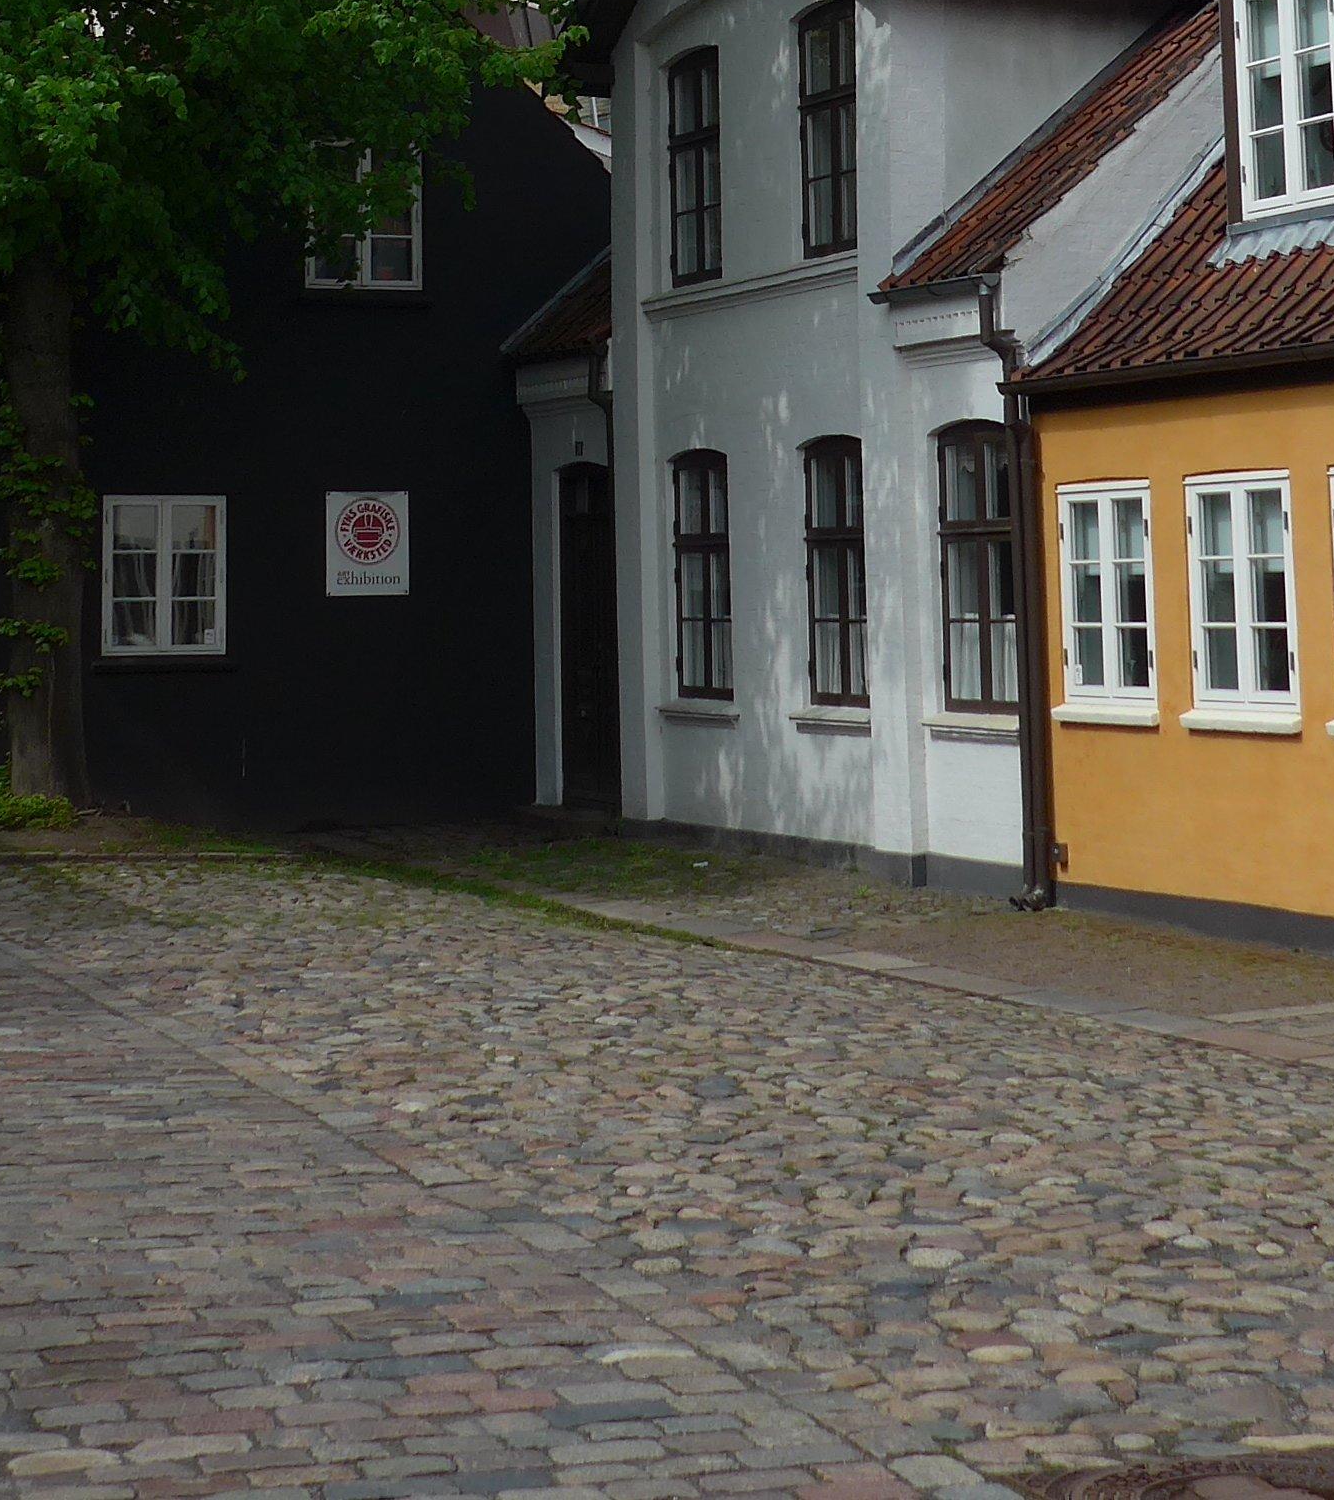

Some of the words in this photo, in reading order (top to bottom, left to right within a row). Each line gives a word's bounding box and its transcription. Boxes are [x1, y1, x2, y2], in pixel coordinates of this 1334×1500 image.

[340, 508, 357, 532] FYNS
[357, 502, 395, 532] GRAFISKE
[343, 538, 392, 560] VÆRKSTED
[336, 571, 400, 585] exhibition
